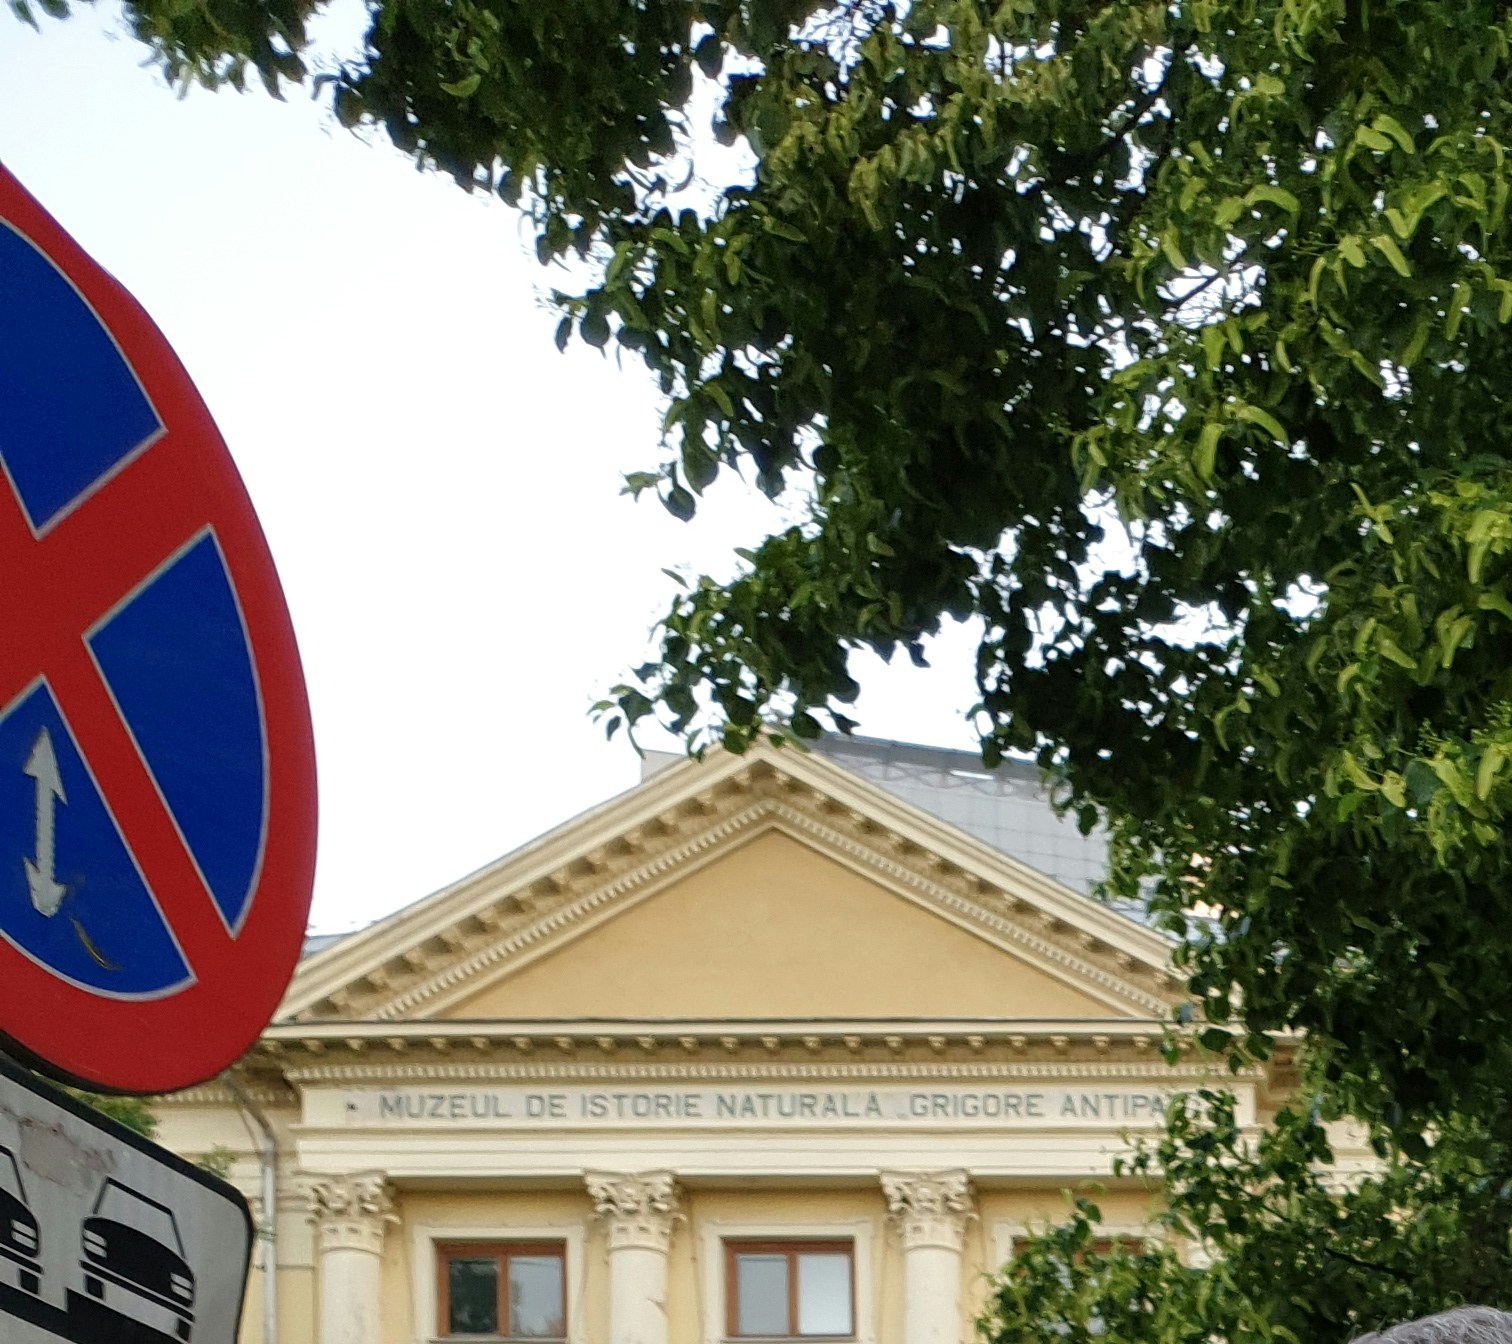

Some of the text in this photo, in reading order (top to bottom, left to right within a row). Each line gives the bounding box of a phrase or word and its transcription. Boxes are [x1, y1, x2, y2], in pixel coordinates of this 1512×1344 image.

[378, 1094, 512, 1119] MUZEUL
[526, 1094, 567, 1118] DE
[582, 1094, 703, 1118] ISTORIE
